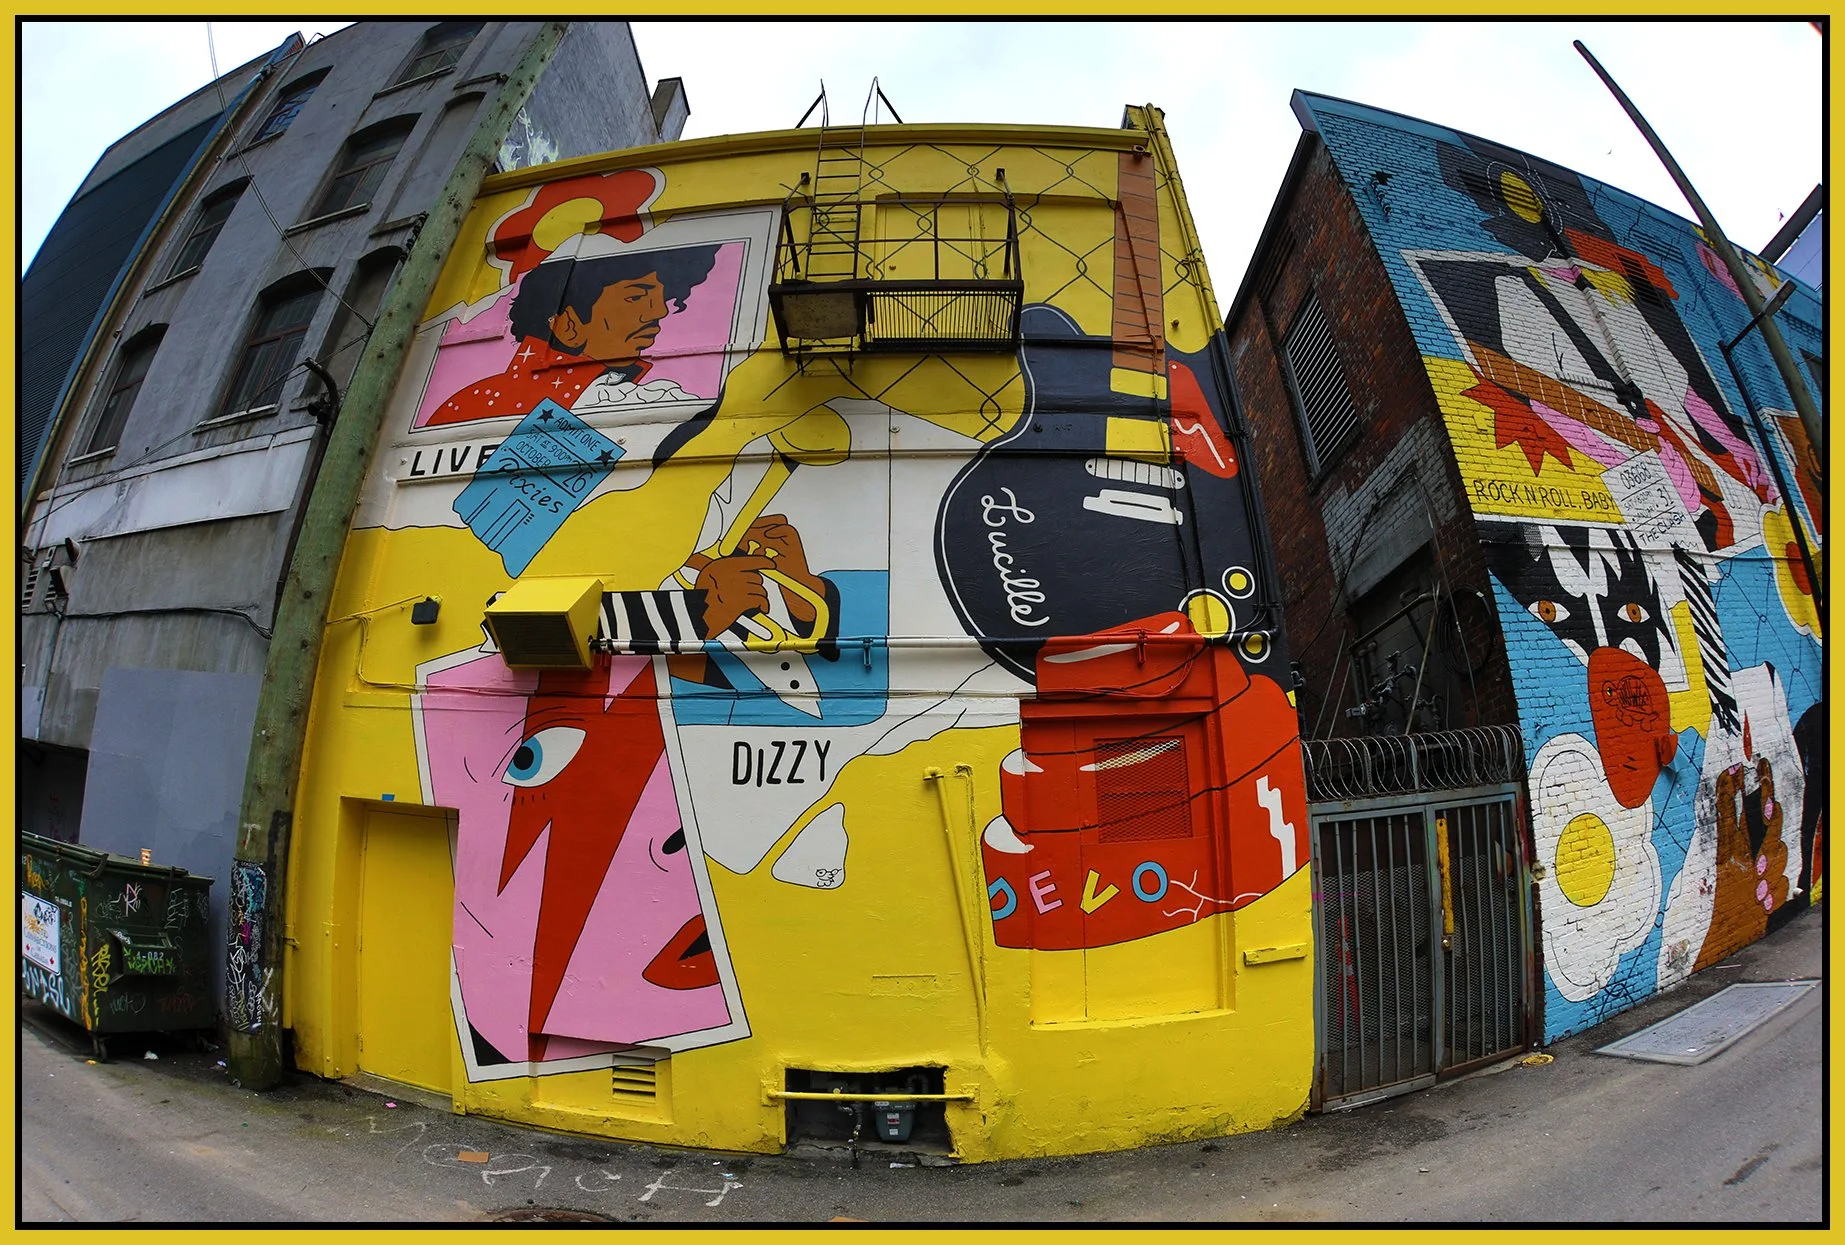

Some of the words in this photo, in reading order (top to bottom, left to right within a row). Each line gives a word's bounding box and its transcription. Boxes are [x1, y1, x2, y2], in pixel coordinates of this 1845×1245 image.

[526, 428, 544, 444] SAT
[554, 417, 585, 440] ADMIT
[580, 433, 602, 452] ONE
[410, 444, 501, 476] LIVE
[515, 441, 552, 467] OCTOBER
[491, 457, 564, 514] Pixies
[562, 460, 594, 493] 26
[1473, 479, 1524, 504] ROCK
[1581, 490, 1615, 511] BABY
[1656, 486, 1675, 507] 31
[1638, 526, 1659, 546] THE
[1656, 511, 1687, 535] CLASH
[981, 487, 1050, 627] Lucille
[732, 740, 831, 788] DIZZY
[988, 860, 1168, 921] DEVO
